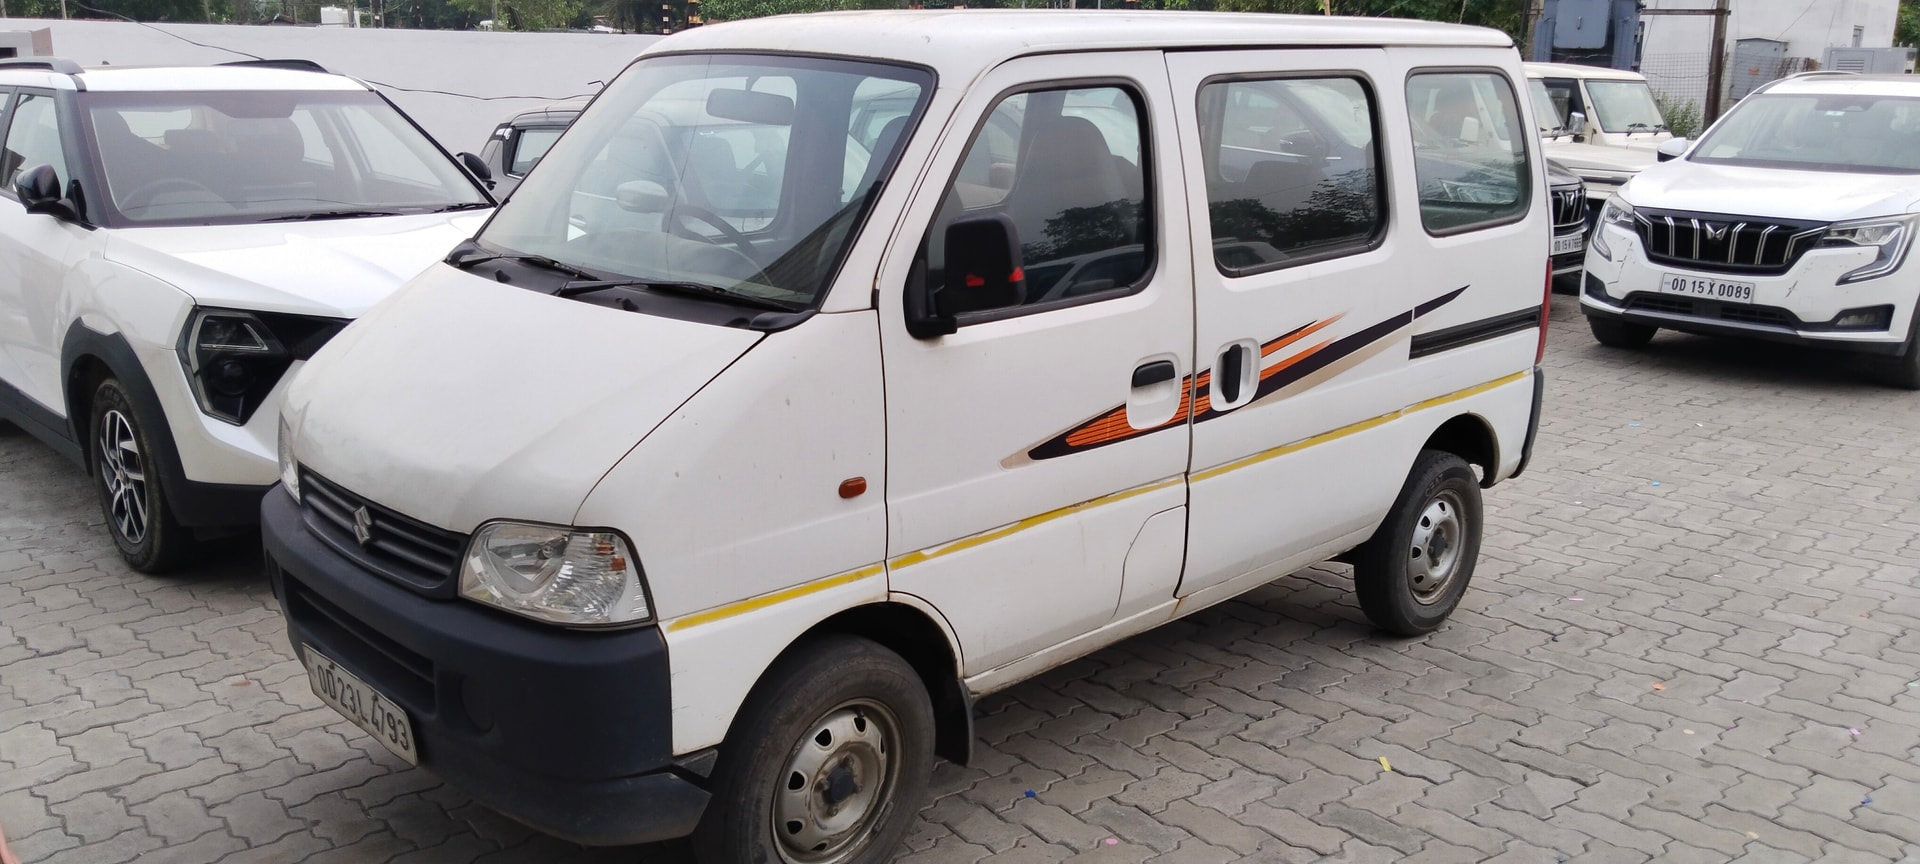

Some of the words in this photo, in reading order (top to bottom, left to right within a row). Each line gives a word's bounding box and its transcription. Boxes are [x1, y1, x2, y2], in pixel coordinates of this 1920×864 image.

[1691, 280, 1705, 294] 15
[1707, 281, 1716, 295] X
[1718, 283, 1751, 299] 0089
[371, 694, 409, 751] 4793
